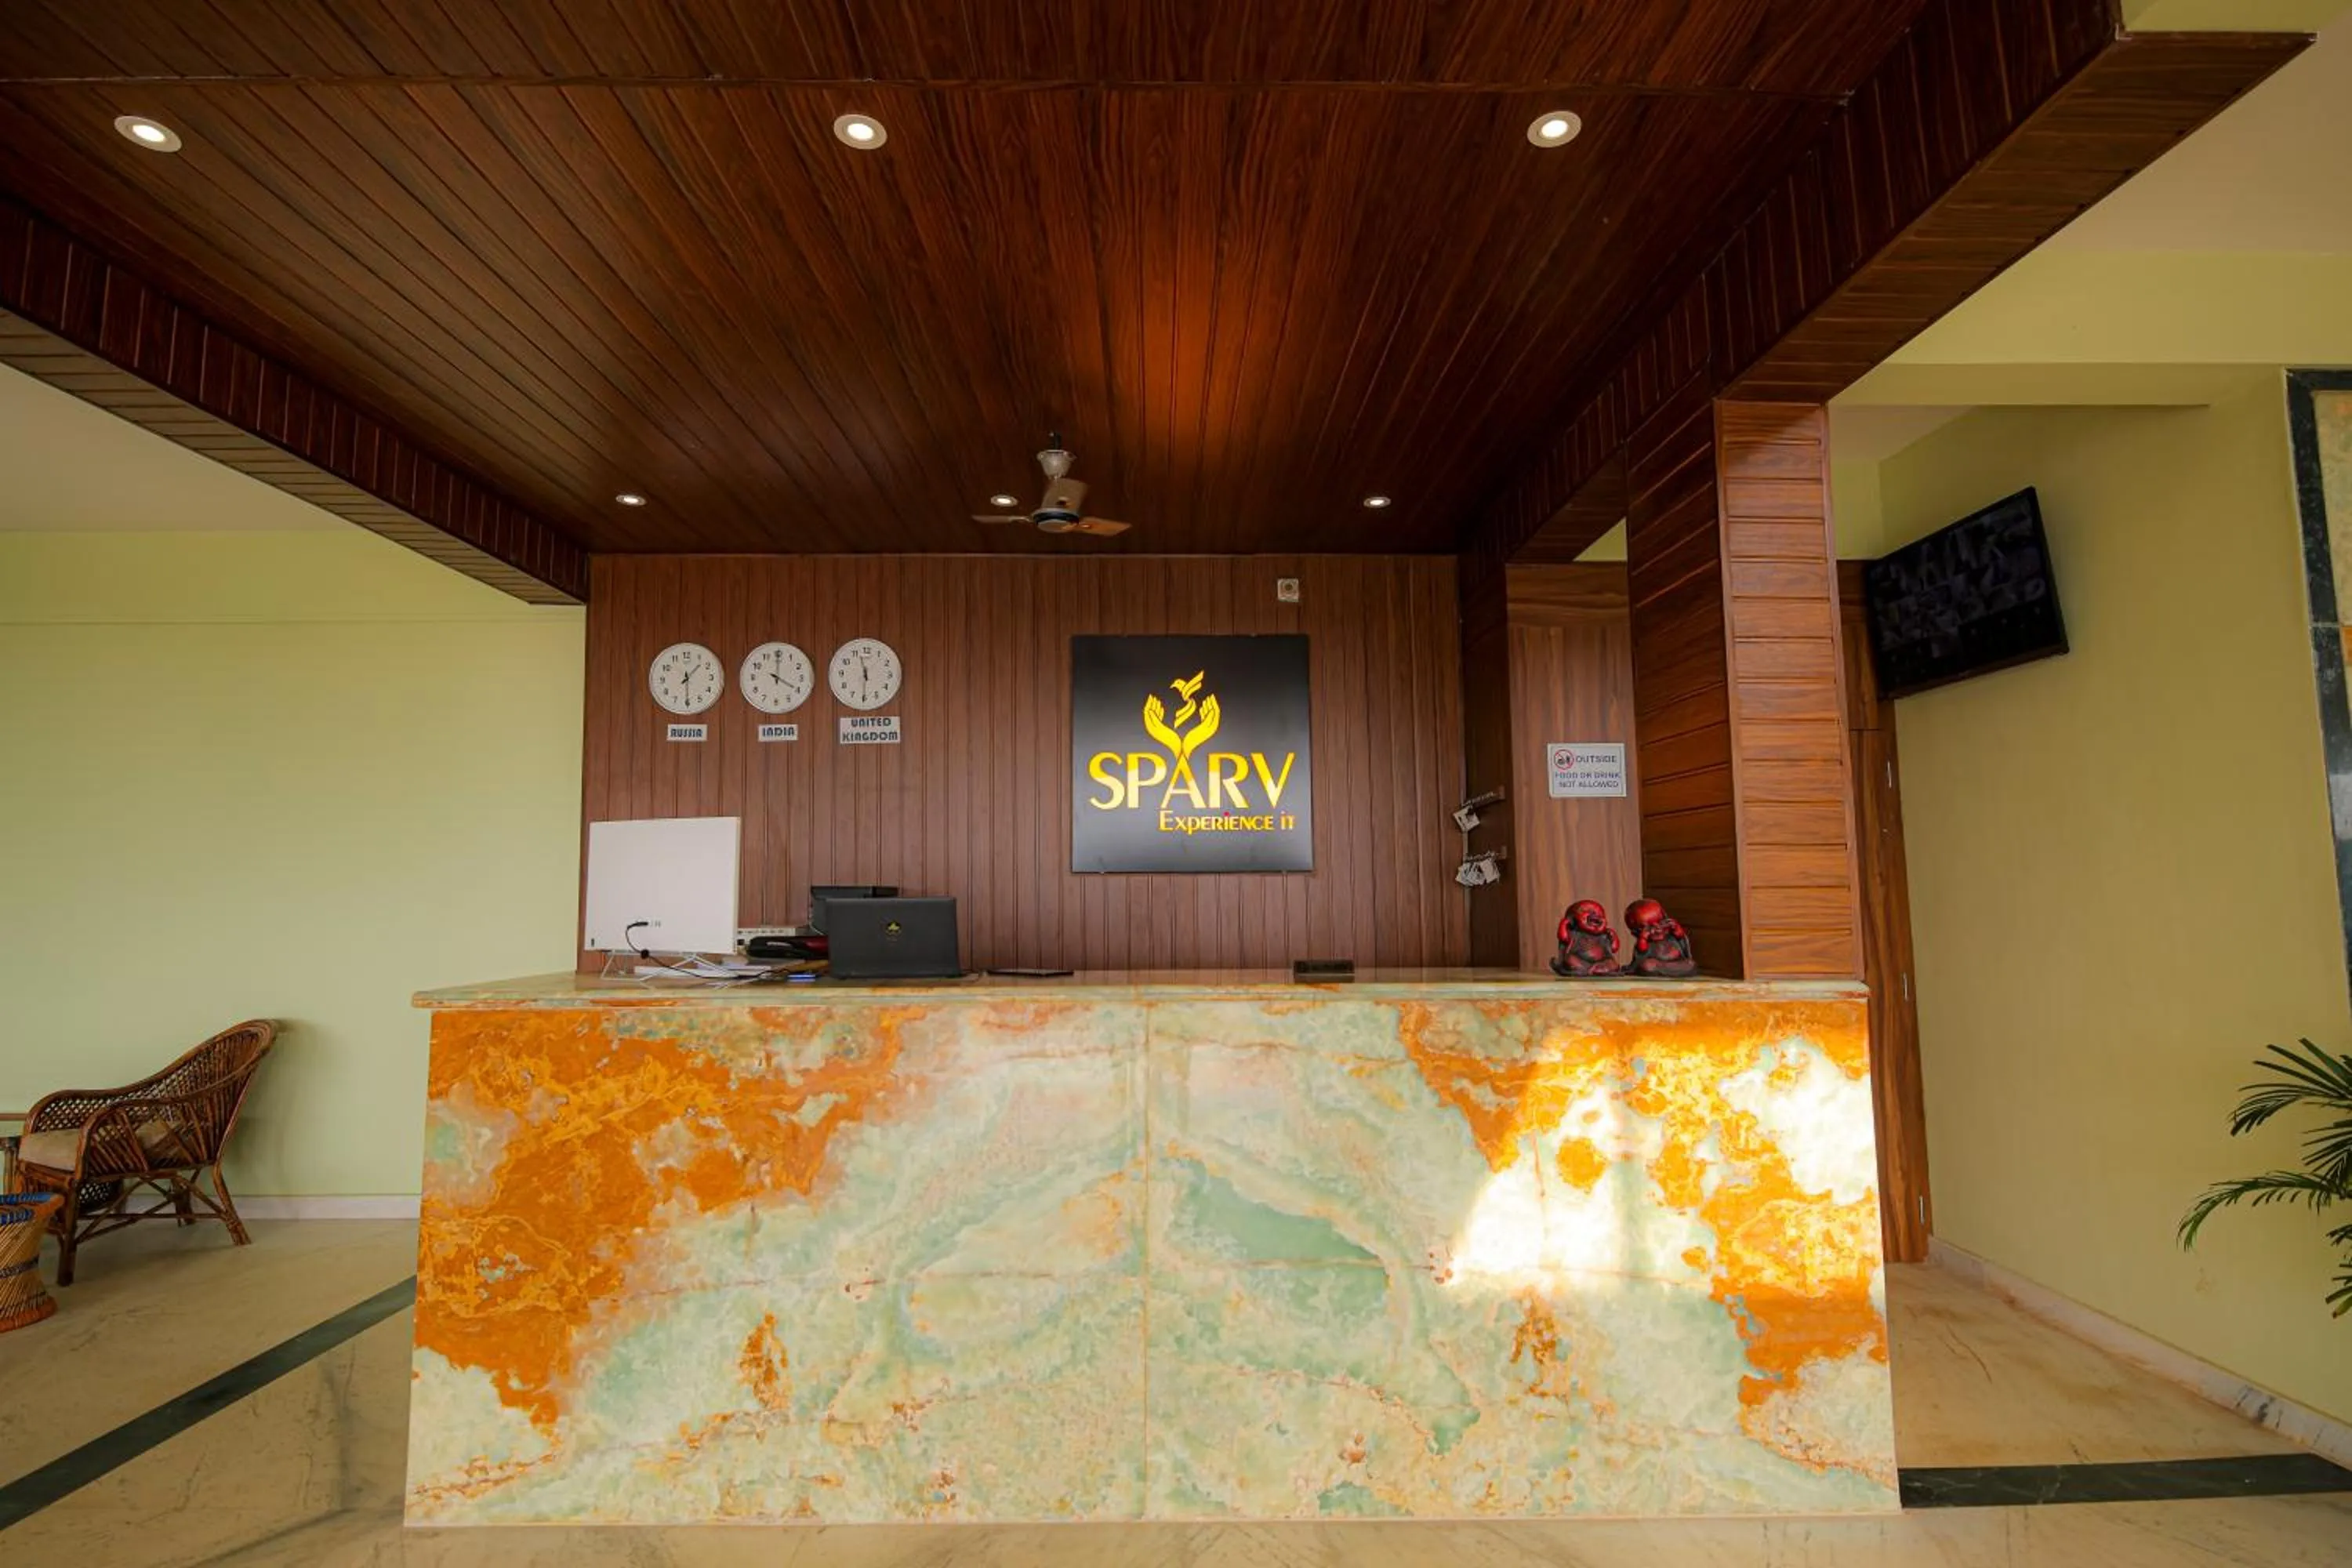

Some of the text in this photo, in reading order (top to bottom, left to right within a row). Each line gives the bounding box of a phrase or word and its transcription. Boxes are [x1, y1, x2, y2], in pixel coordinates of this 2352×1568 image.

[851, 718, 891, 728] UNITED
[670, 728, 702, 738] RUSSIA
[762, 728, 795, 737] INDIA
[842, 731, 898, 742] KINGDOM
[1088, 751, 1296, 810] SPARV
